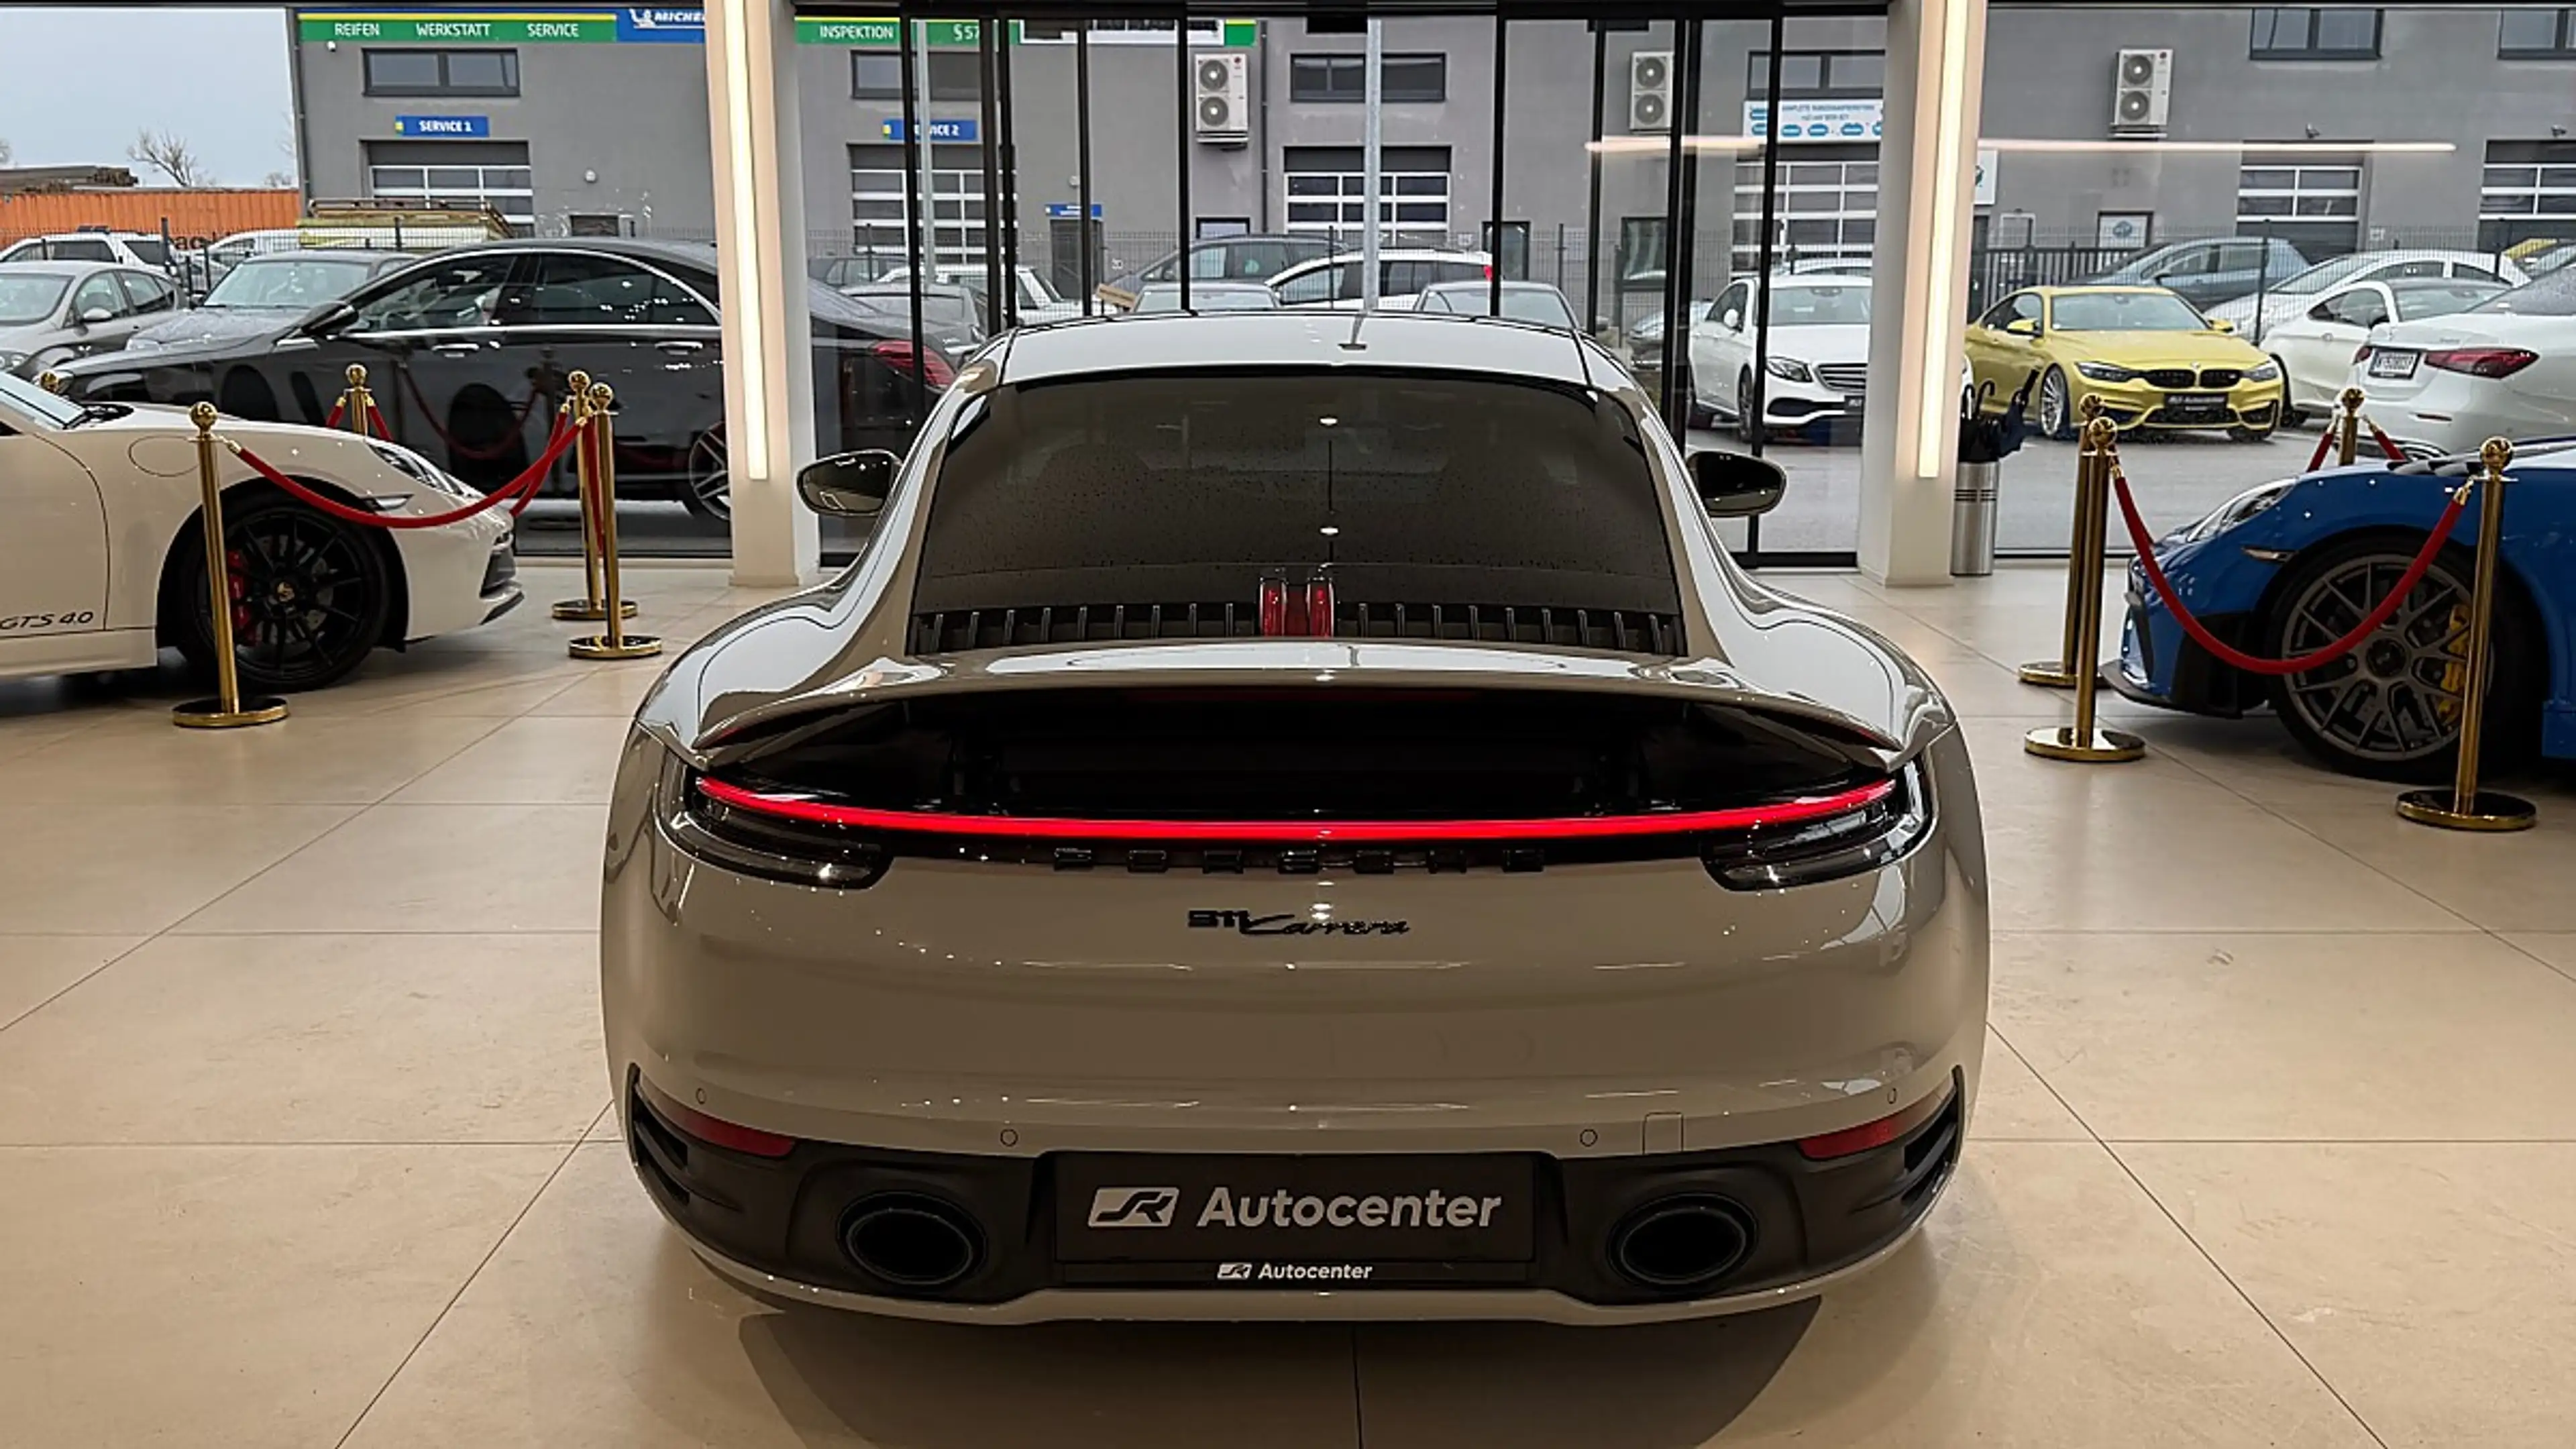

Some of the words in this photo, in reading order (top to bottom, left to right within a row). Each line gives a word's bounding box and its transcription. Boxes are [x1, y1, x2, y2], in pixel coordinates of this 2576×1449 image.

[654, 11, 705, 22] MICHE
[334, 23, 380, 36] REIFEN
[416, 23, 491, 36] WERKSTATT
[527, 23, 579, 38] SERVICE
[820, 25, 894, 38] INSPEKTION
[419, 120, 463, 132] SERVICE
[951, 124, 959, 136] 2
[0, 613, 56, 630] GTS
[1187, 909, 1250, 928] 911
[1240, 914, 1410, 935] Carrera
[1196, 1186, 1501, 1228] Autocenter
[1258, 1263, 1373, 1280] Autocenter
